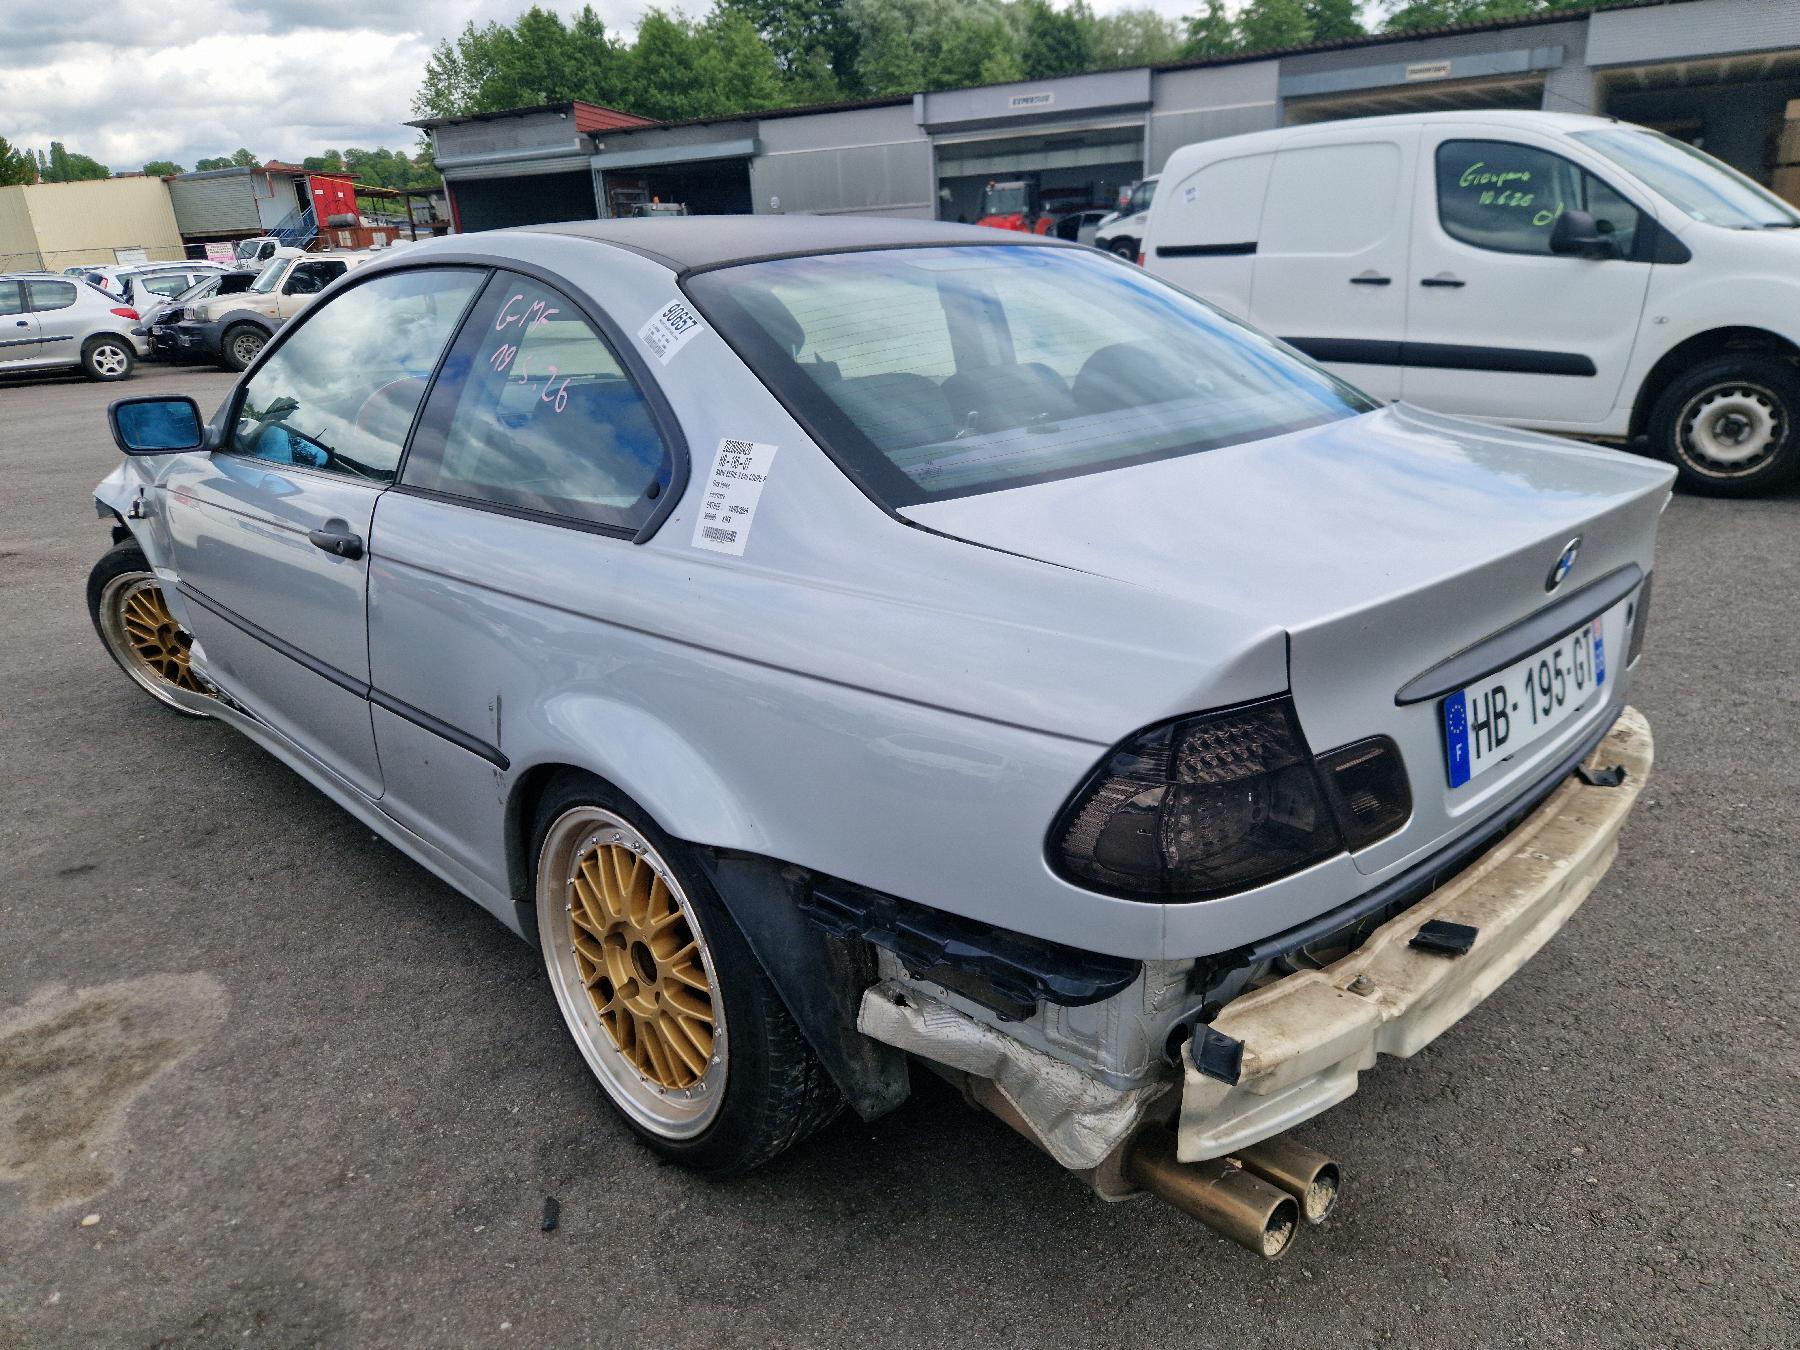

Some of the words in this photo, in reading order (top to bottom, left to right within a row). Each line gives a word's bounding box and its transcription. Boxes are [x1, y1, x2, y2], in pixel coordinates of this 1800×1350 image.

[662, 303, 698, 335] 90657
[1472, 628, 1592, 759] HB-195-GT
[1455, 743, 1463, 761] F
